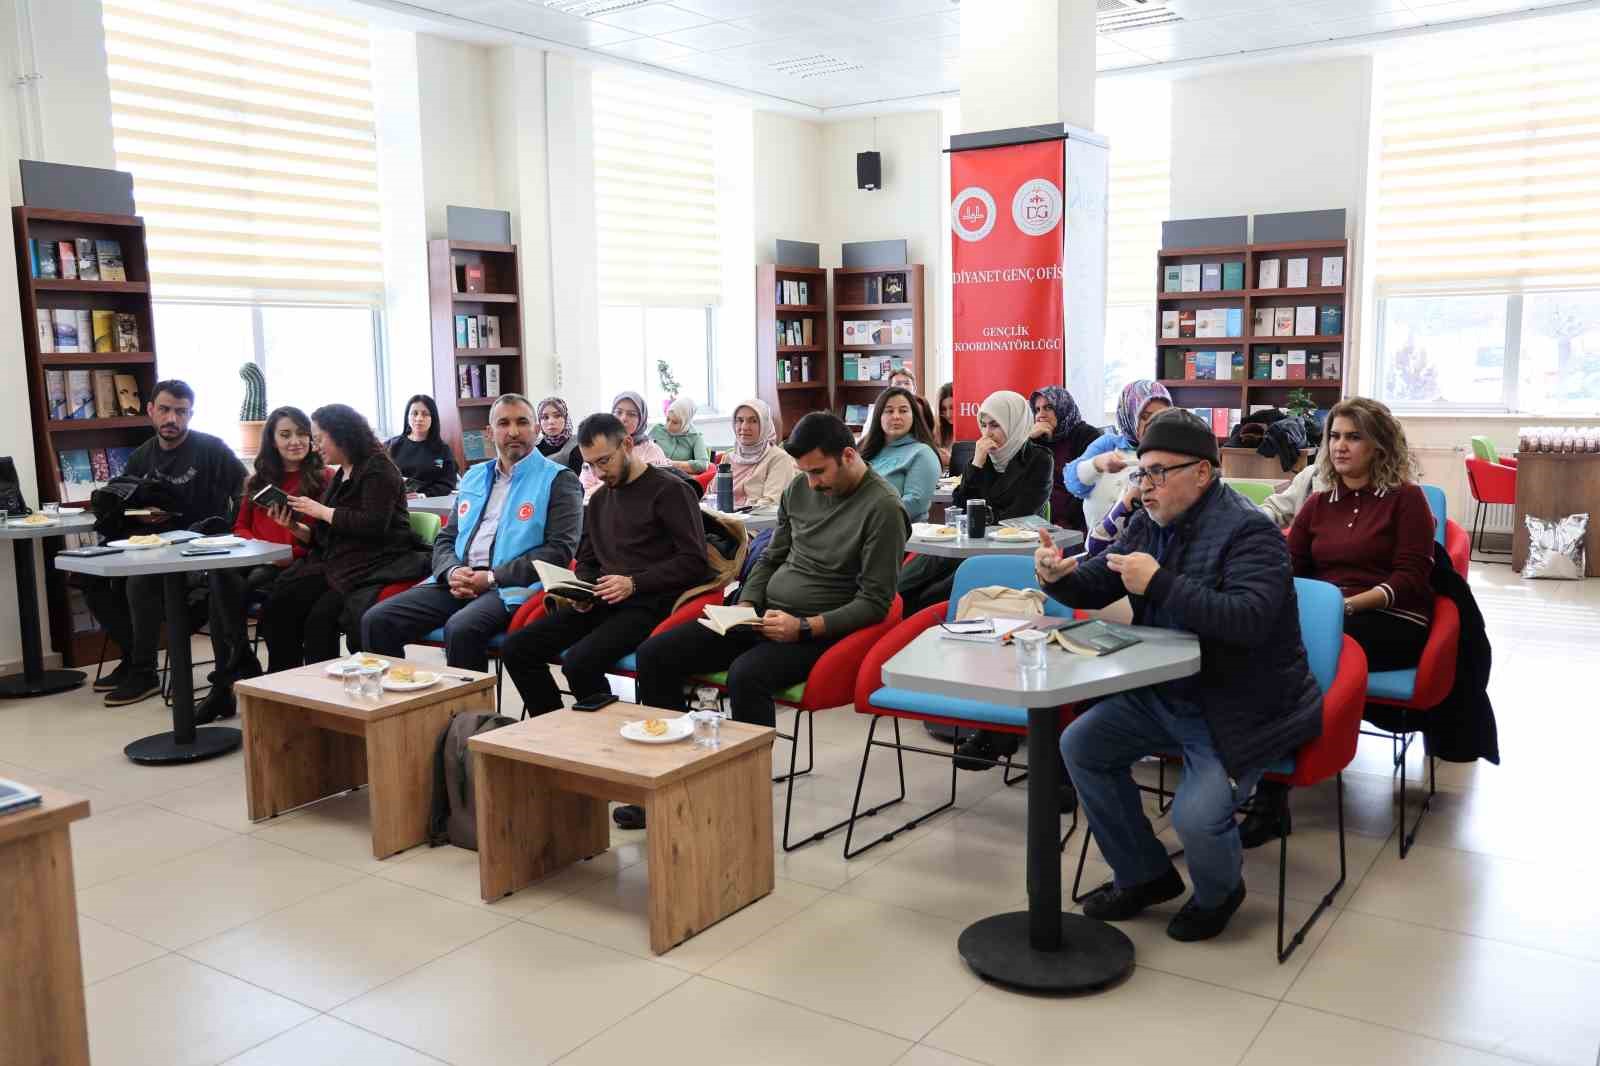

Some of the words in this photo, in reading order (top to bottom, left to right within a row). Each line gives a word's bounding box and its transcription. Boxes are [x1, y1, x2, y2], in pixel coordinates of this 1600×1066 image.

[953, 269, 1001, 284] DİYANET
[1002, 267, 1034, 284] GENÇ
[983, 324, 1029, 338] GENÇLİK
[954, 337, 1061, 352] KOORDİNATÖRLÜĞÜ
[960, 402, 980, 417] HO
